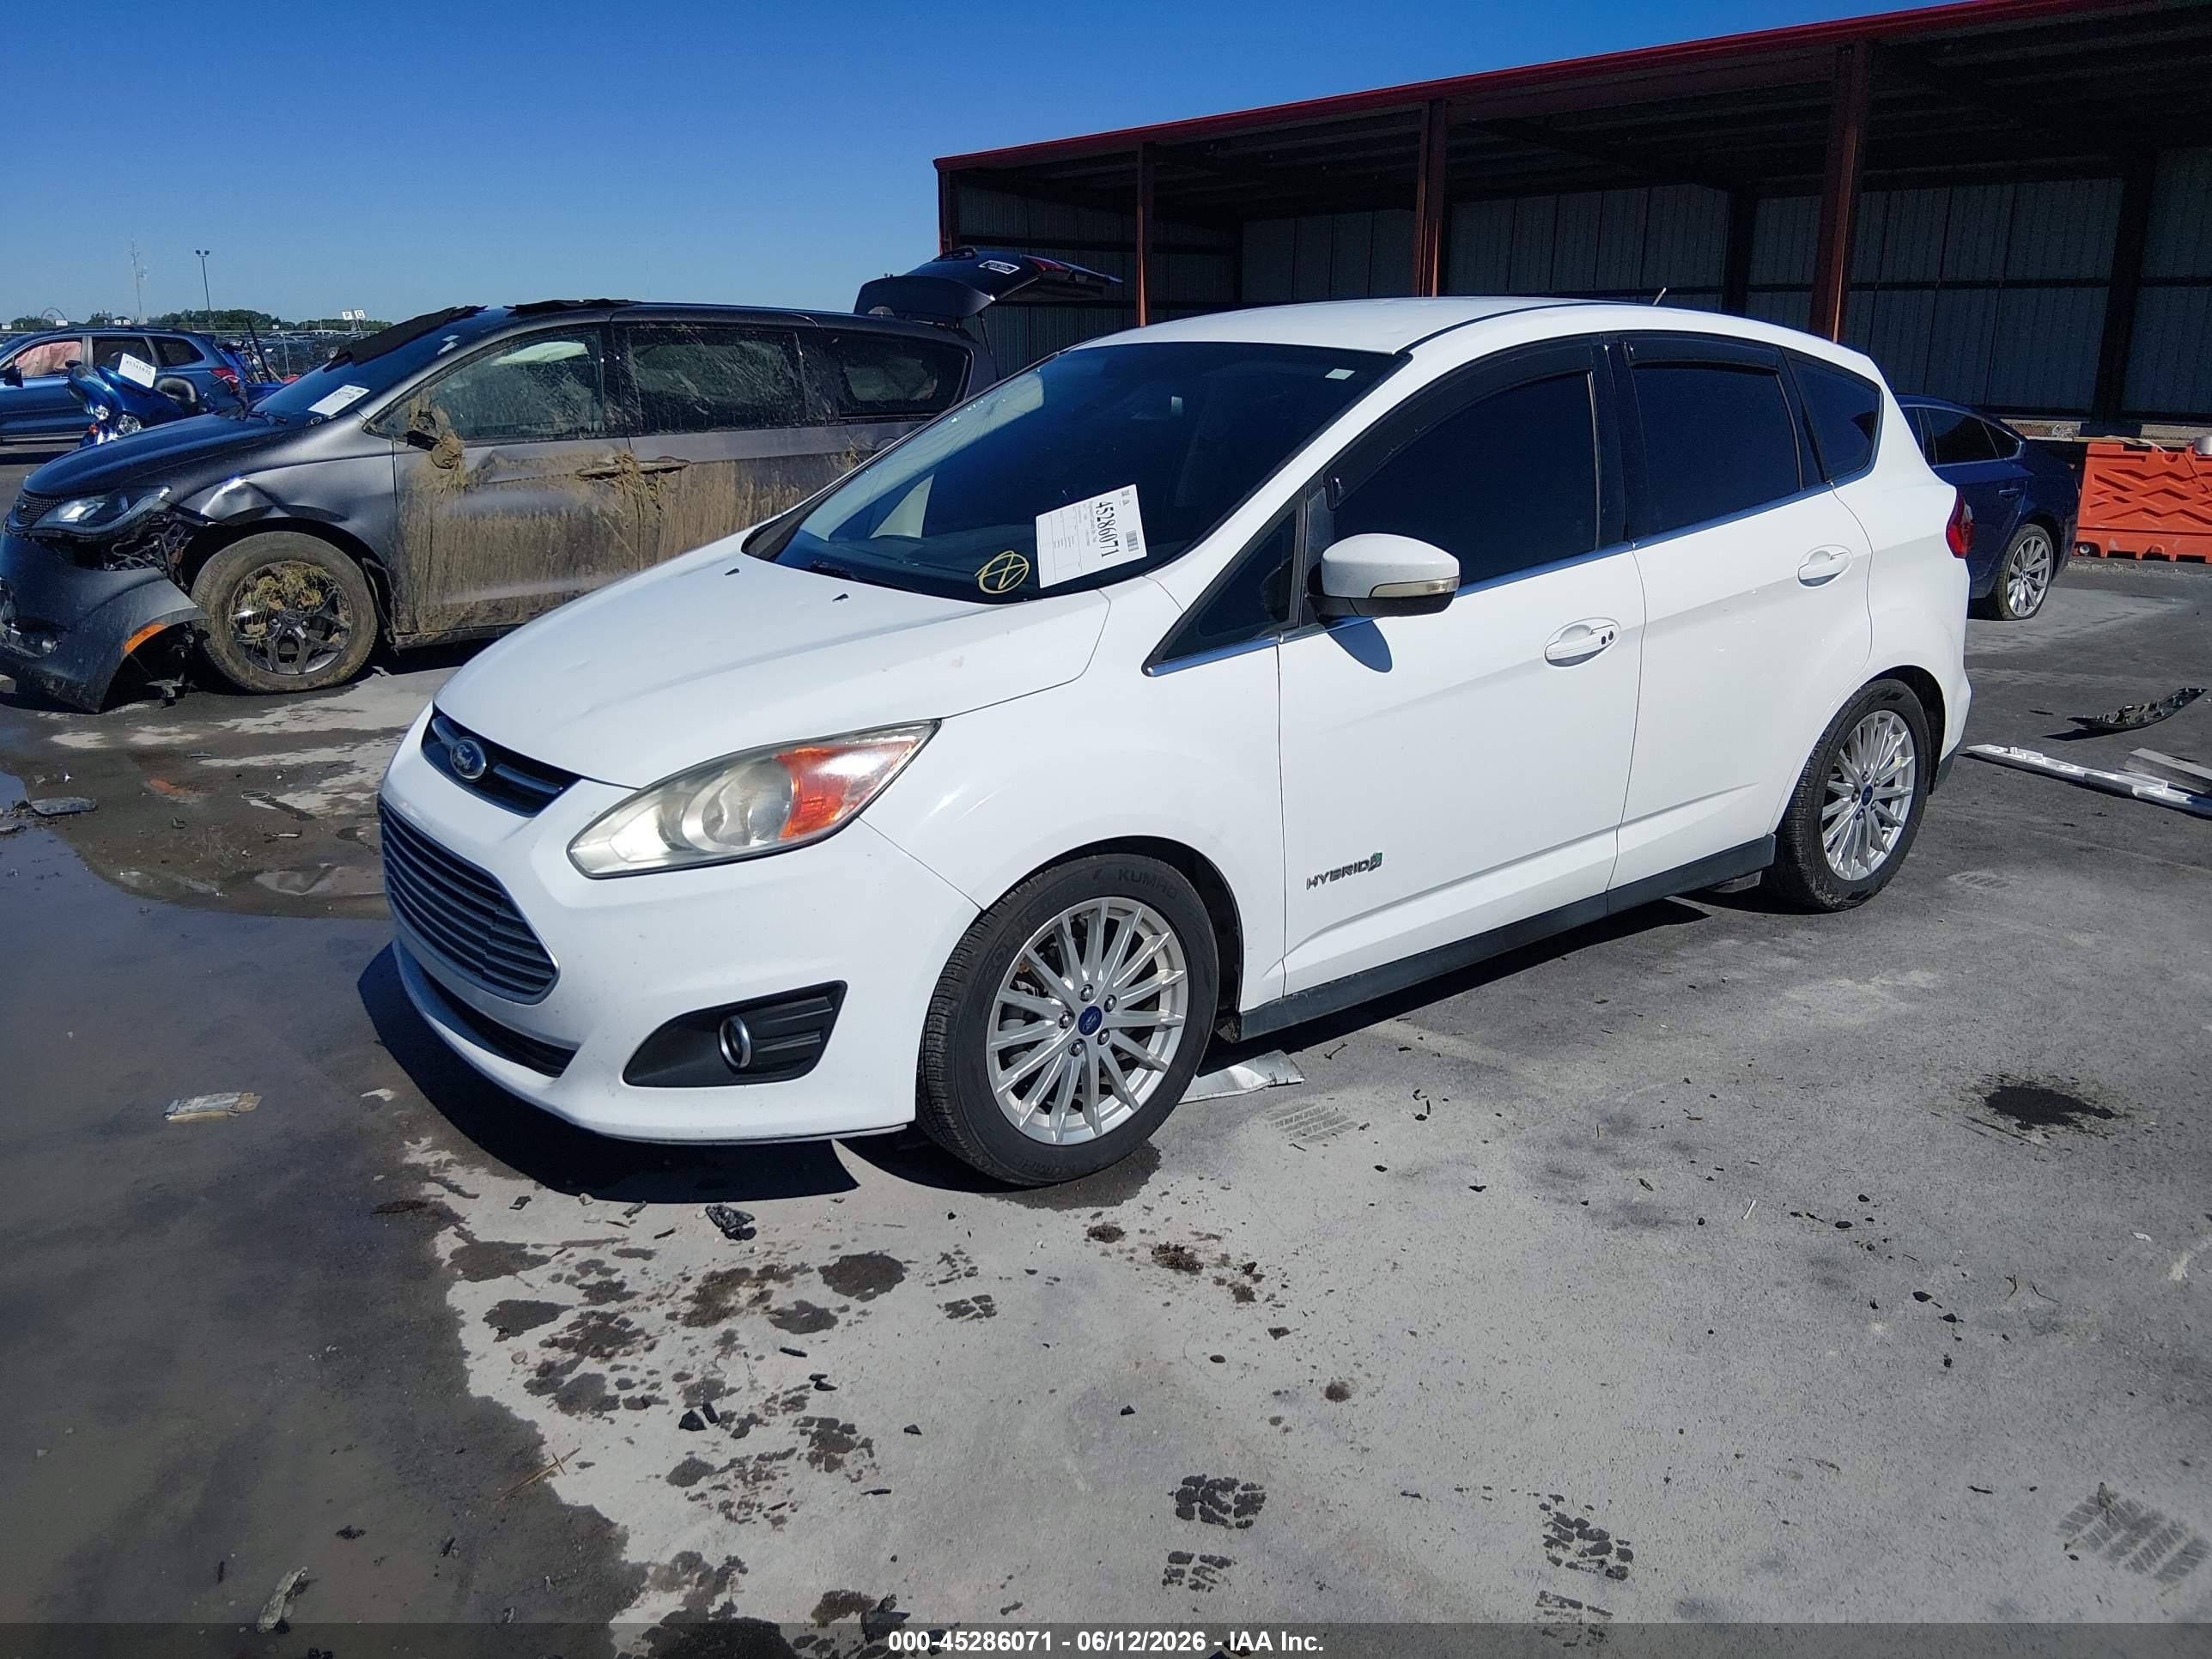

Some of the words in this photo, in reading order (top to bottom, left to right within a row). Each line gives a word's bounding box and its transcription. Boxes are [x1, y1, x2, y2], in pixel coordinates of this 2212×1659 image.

[1095, 500, 1120, 559] 45286071
[1118, 866, 1178, 900] KUMHO
[1306, 858, 1370, 890] HYBRID
